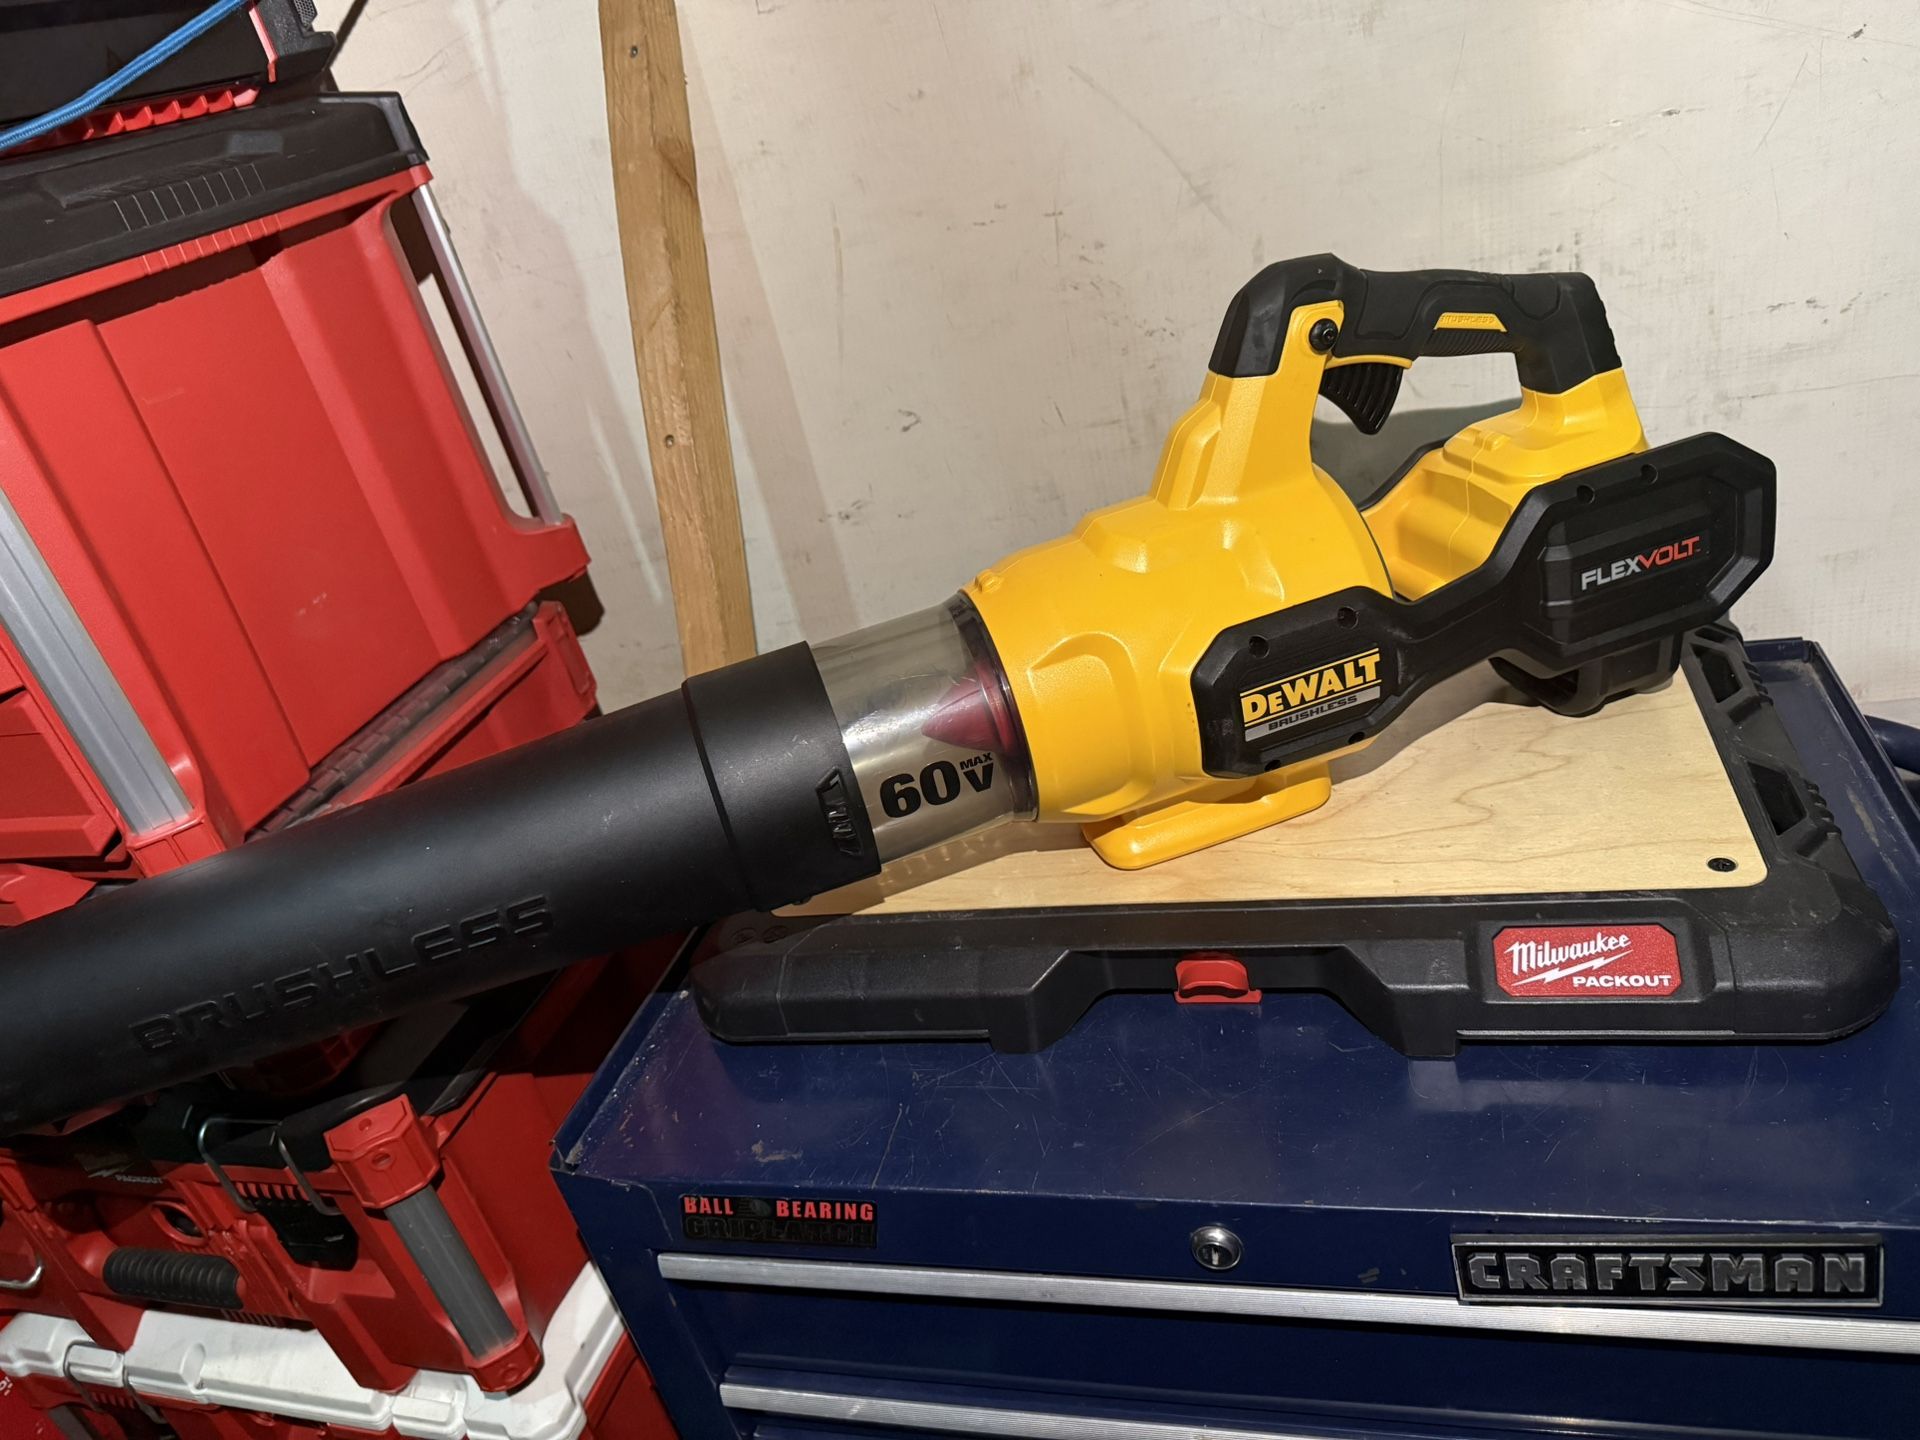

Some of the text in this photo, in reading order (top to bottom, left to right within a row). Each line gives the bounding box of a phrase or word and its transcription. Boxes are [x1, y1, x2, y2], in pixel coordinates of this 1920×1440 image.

[1581, 536, 1700, 591] FLEXVOLT
[1268, 695, 1358, 731] BRUSHLESS
[959, 752, 993, 770] MAX
[880, 761, 994, 818] 60V
[128, 895, 555, 1053] BRUSHLESS
[1504, 932, 1632, 976] Milwaukee
[1572, 974, 1672, 988] PACKOUT
[684, 1196, 874, 1221] BALL BEARING
[1467, 1252, 1866, 1293] CRAFTSMAN
